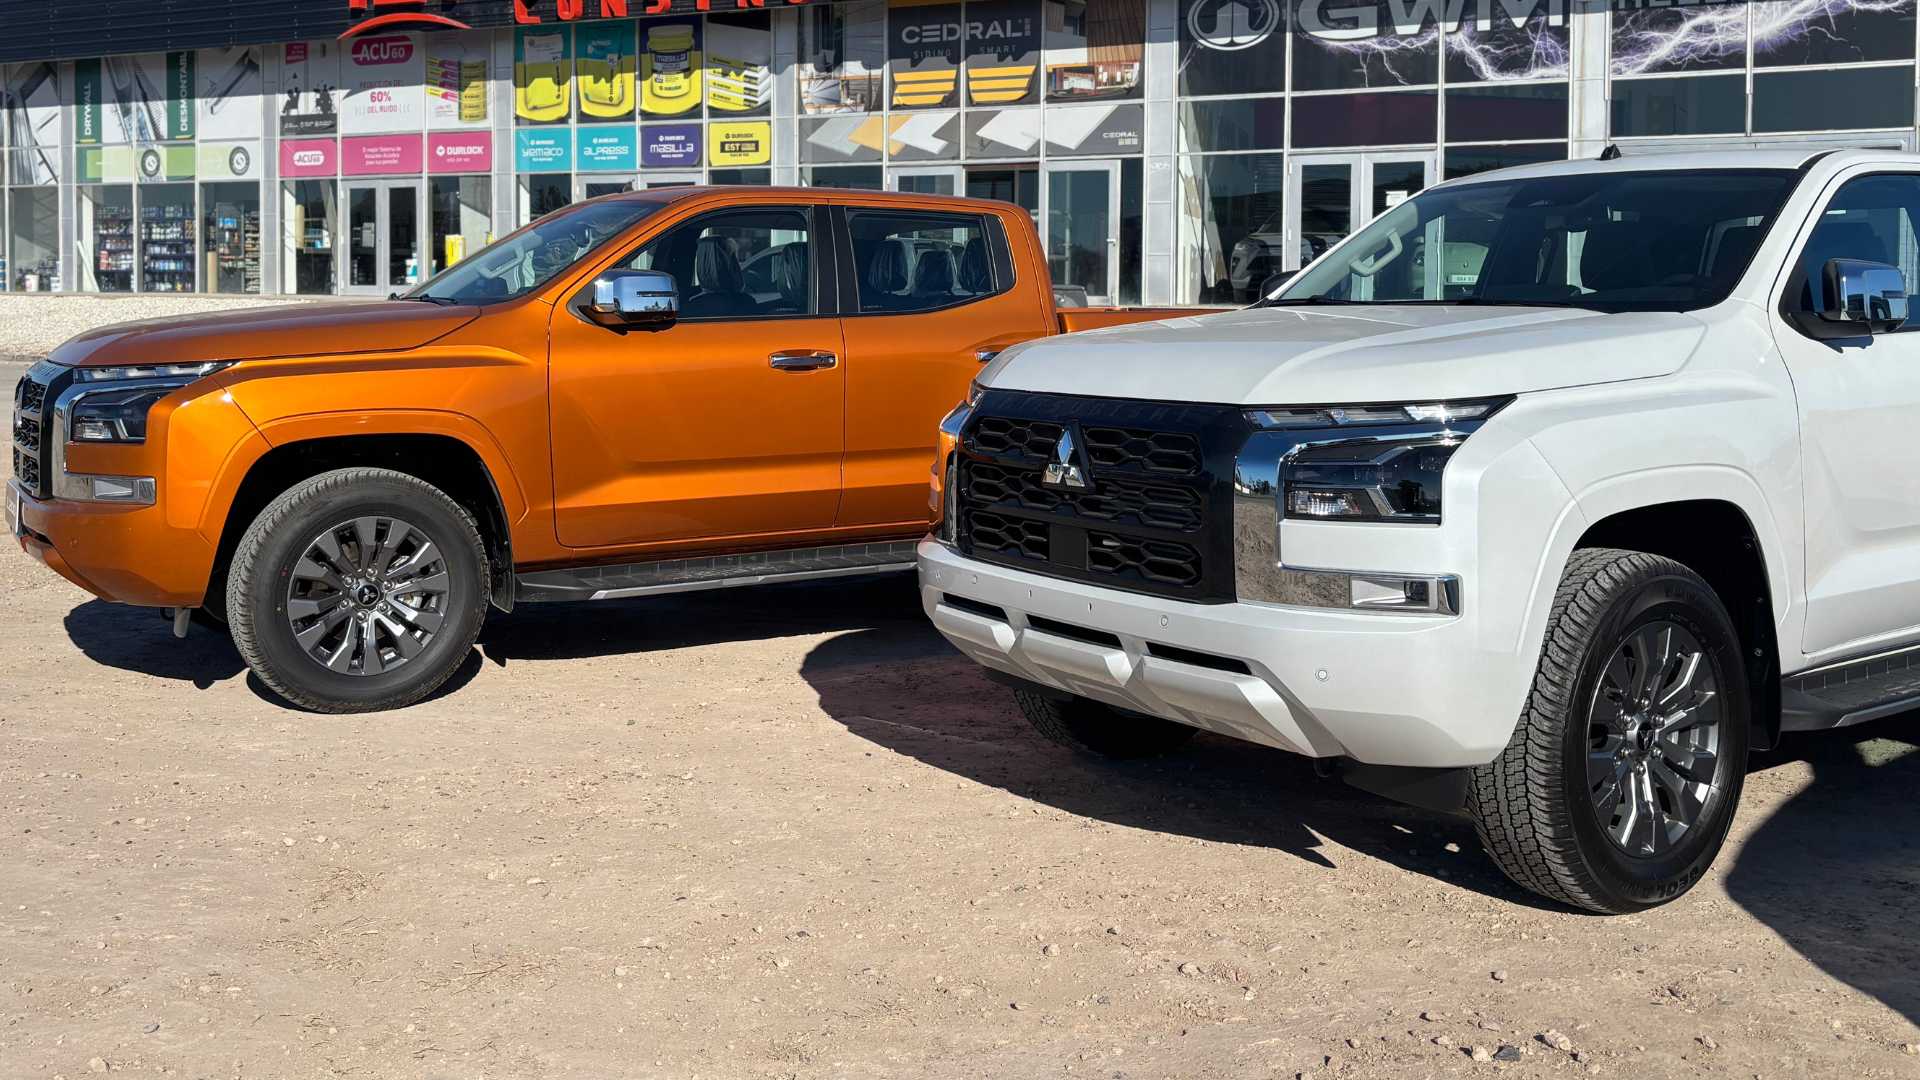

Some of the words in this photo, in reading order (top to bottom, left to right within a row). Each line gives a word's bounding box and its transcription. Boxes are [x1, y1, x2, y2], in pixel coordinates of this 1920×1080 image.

[901, 20, 1013, 44] CEDRAL
[979, 44, 1016, 55] SMART
[370, 91, 391, 102] 60%
[84, 81, 92, 135] DRYWALL
